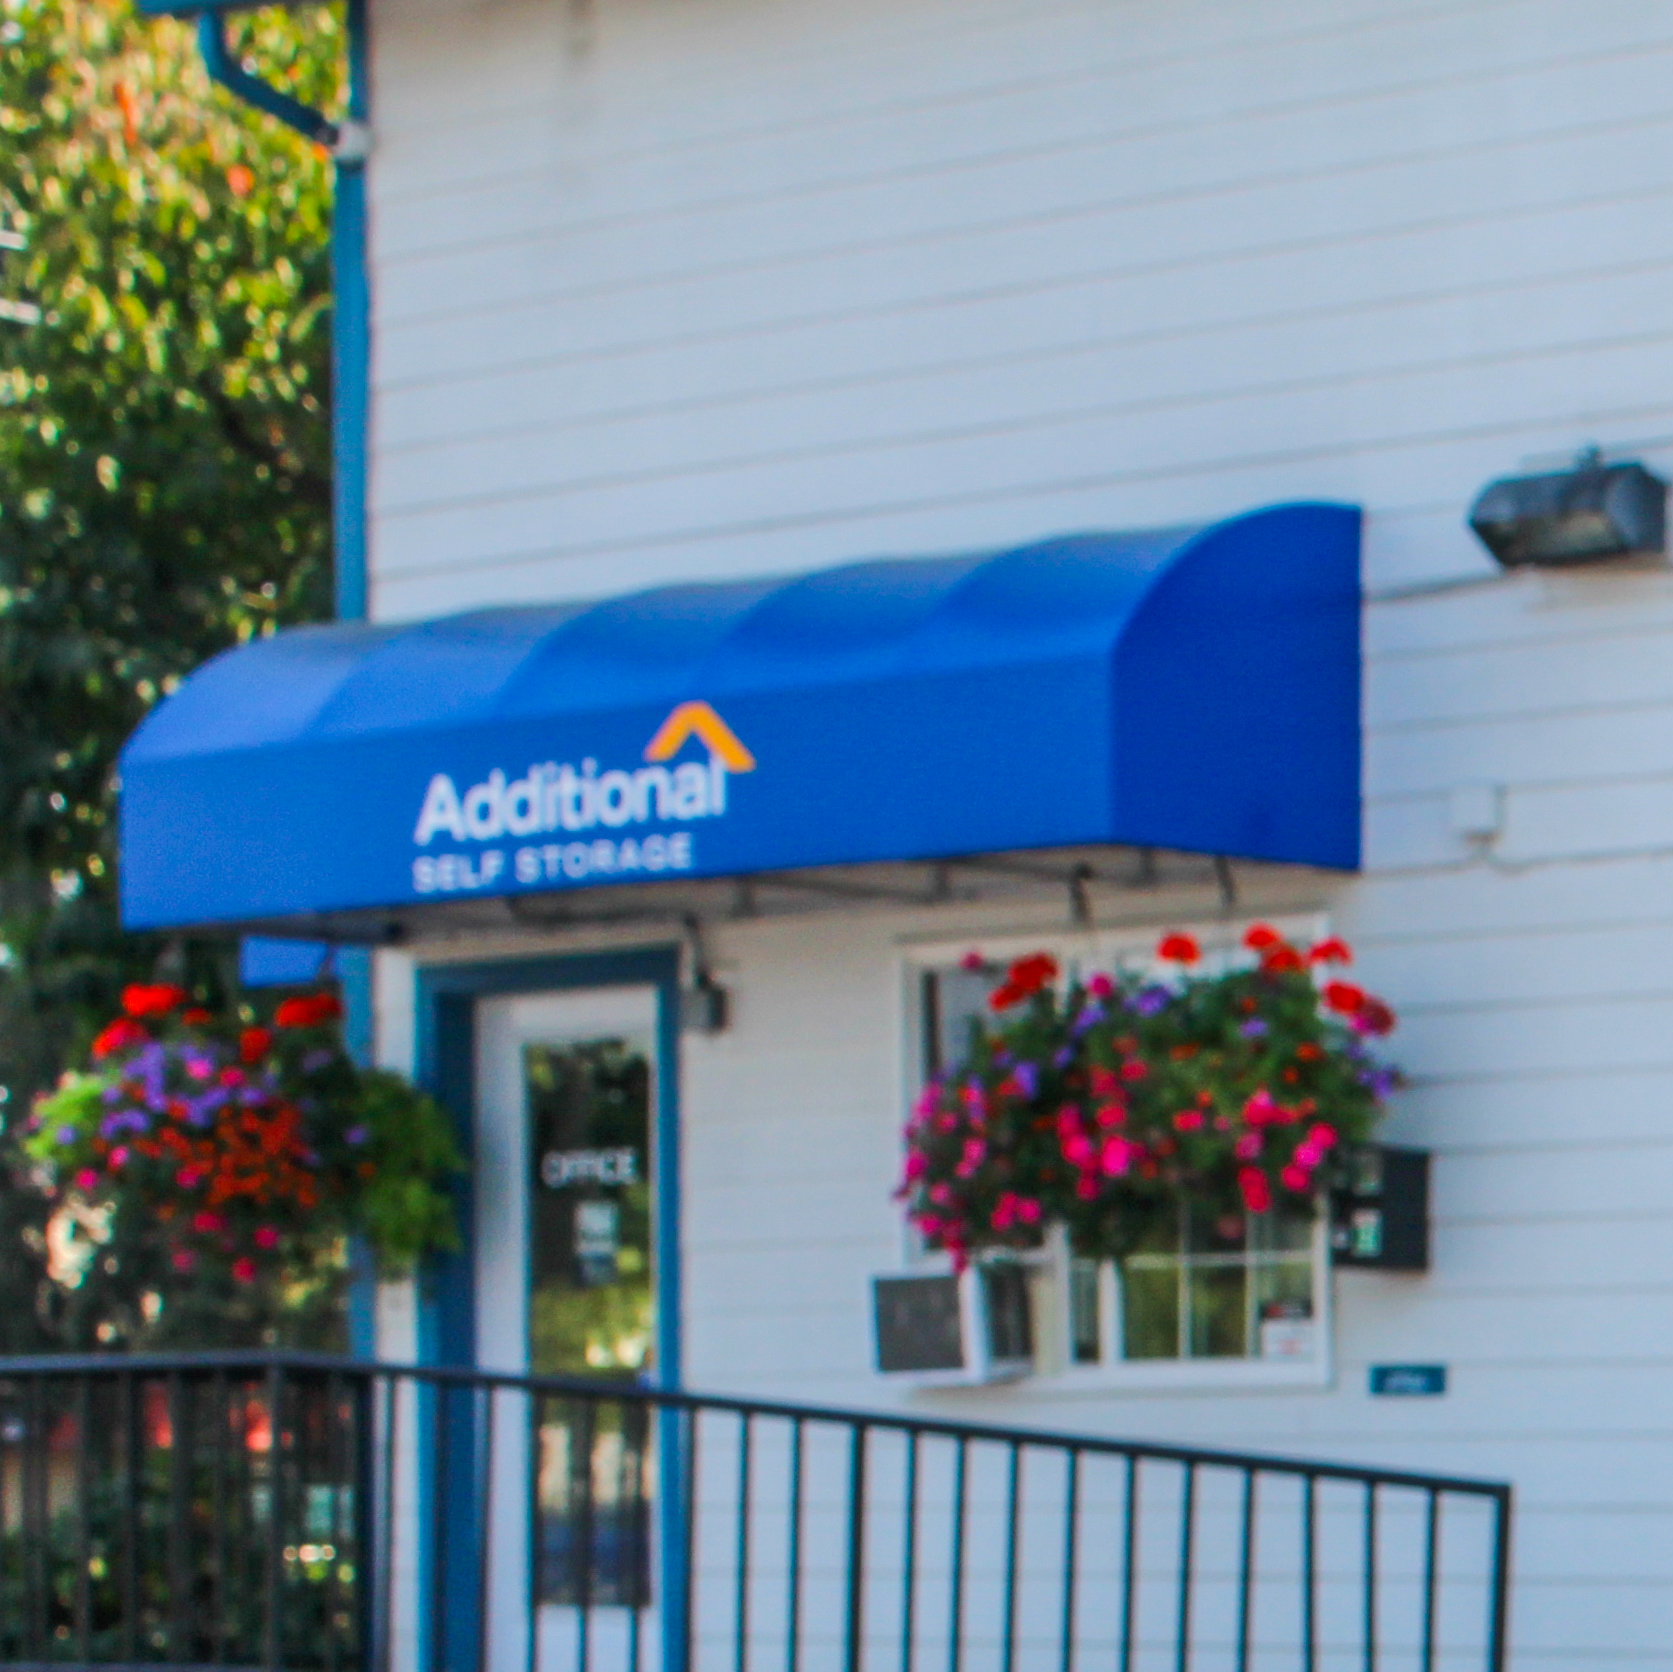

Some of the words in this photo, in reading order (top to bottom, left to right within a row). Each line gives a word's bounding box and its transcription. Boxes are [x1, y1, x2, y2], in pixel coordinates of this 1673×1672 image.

[414, 755, 728, 847] Additional
[413, 850, 504, 893] SELF
[515, 832, 693, 884] STORAGE
[541, 1148, 637, 1188] OFFICE
